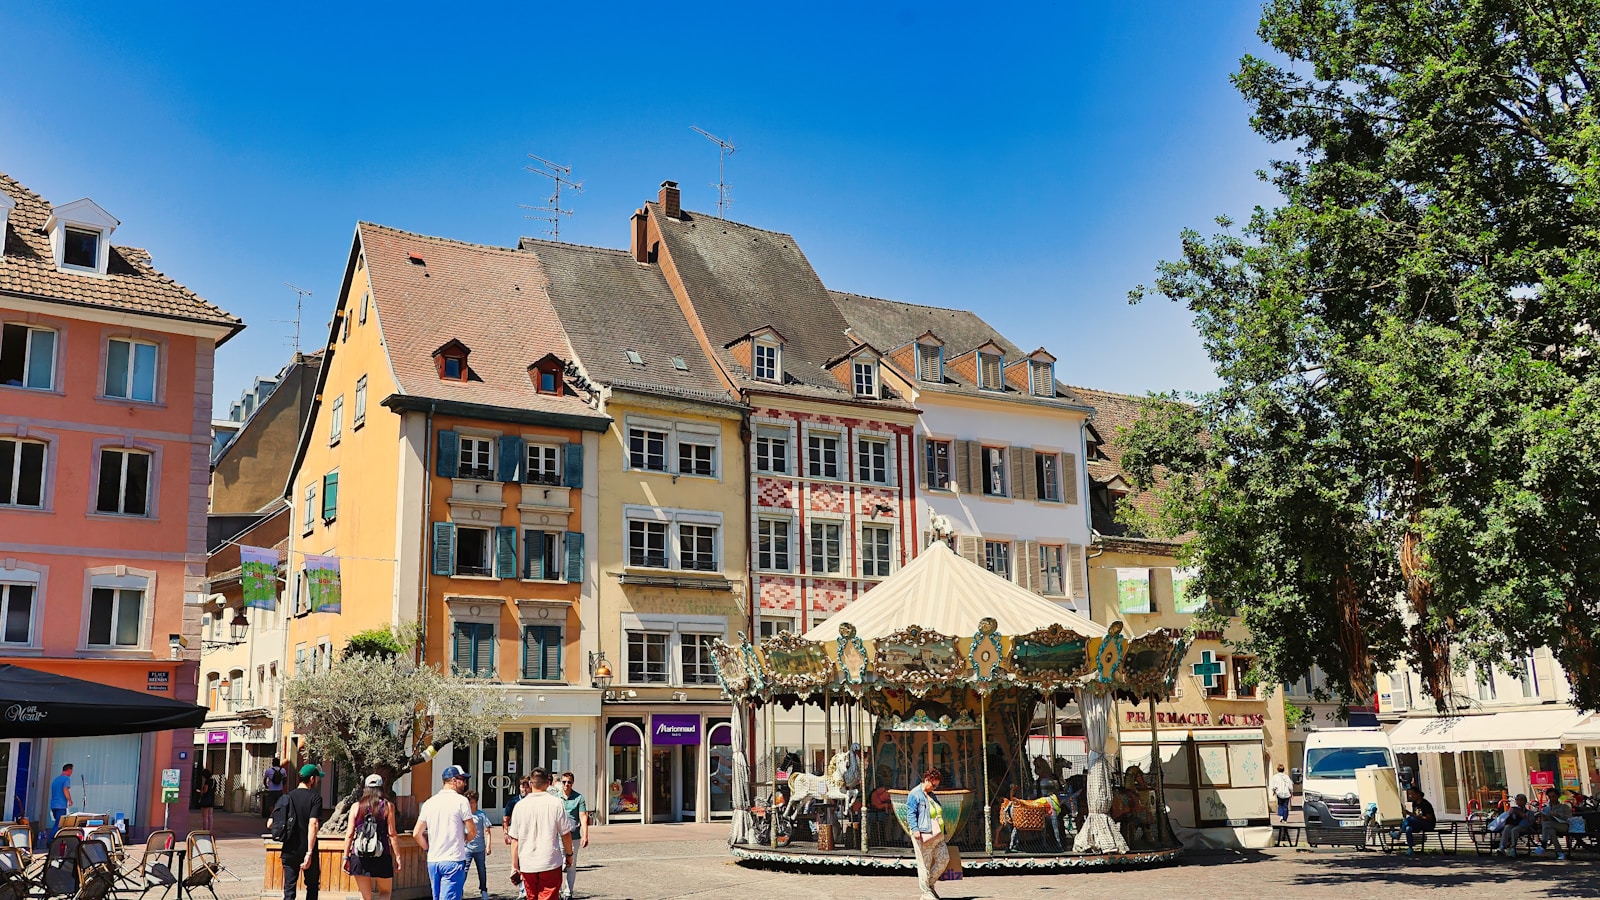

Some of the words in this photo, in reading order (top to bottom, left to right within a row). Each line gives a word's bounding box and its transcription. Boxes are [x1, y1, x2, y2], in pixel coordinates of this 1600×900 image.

[1219, 712, 1236, 726] AU
[1240, 713, 1265, 726] LYS
[656, 723, 696, 734] Marionnaud
